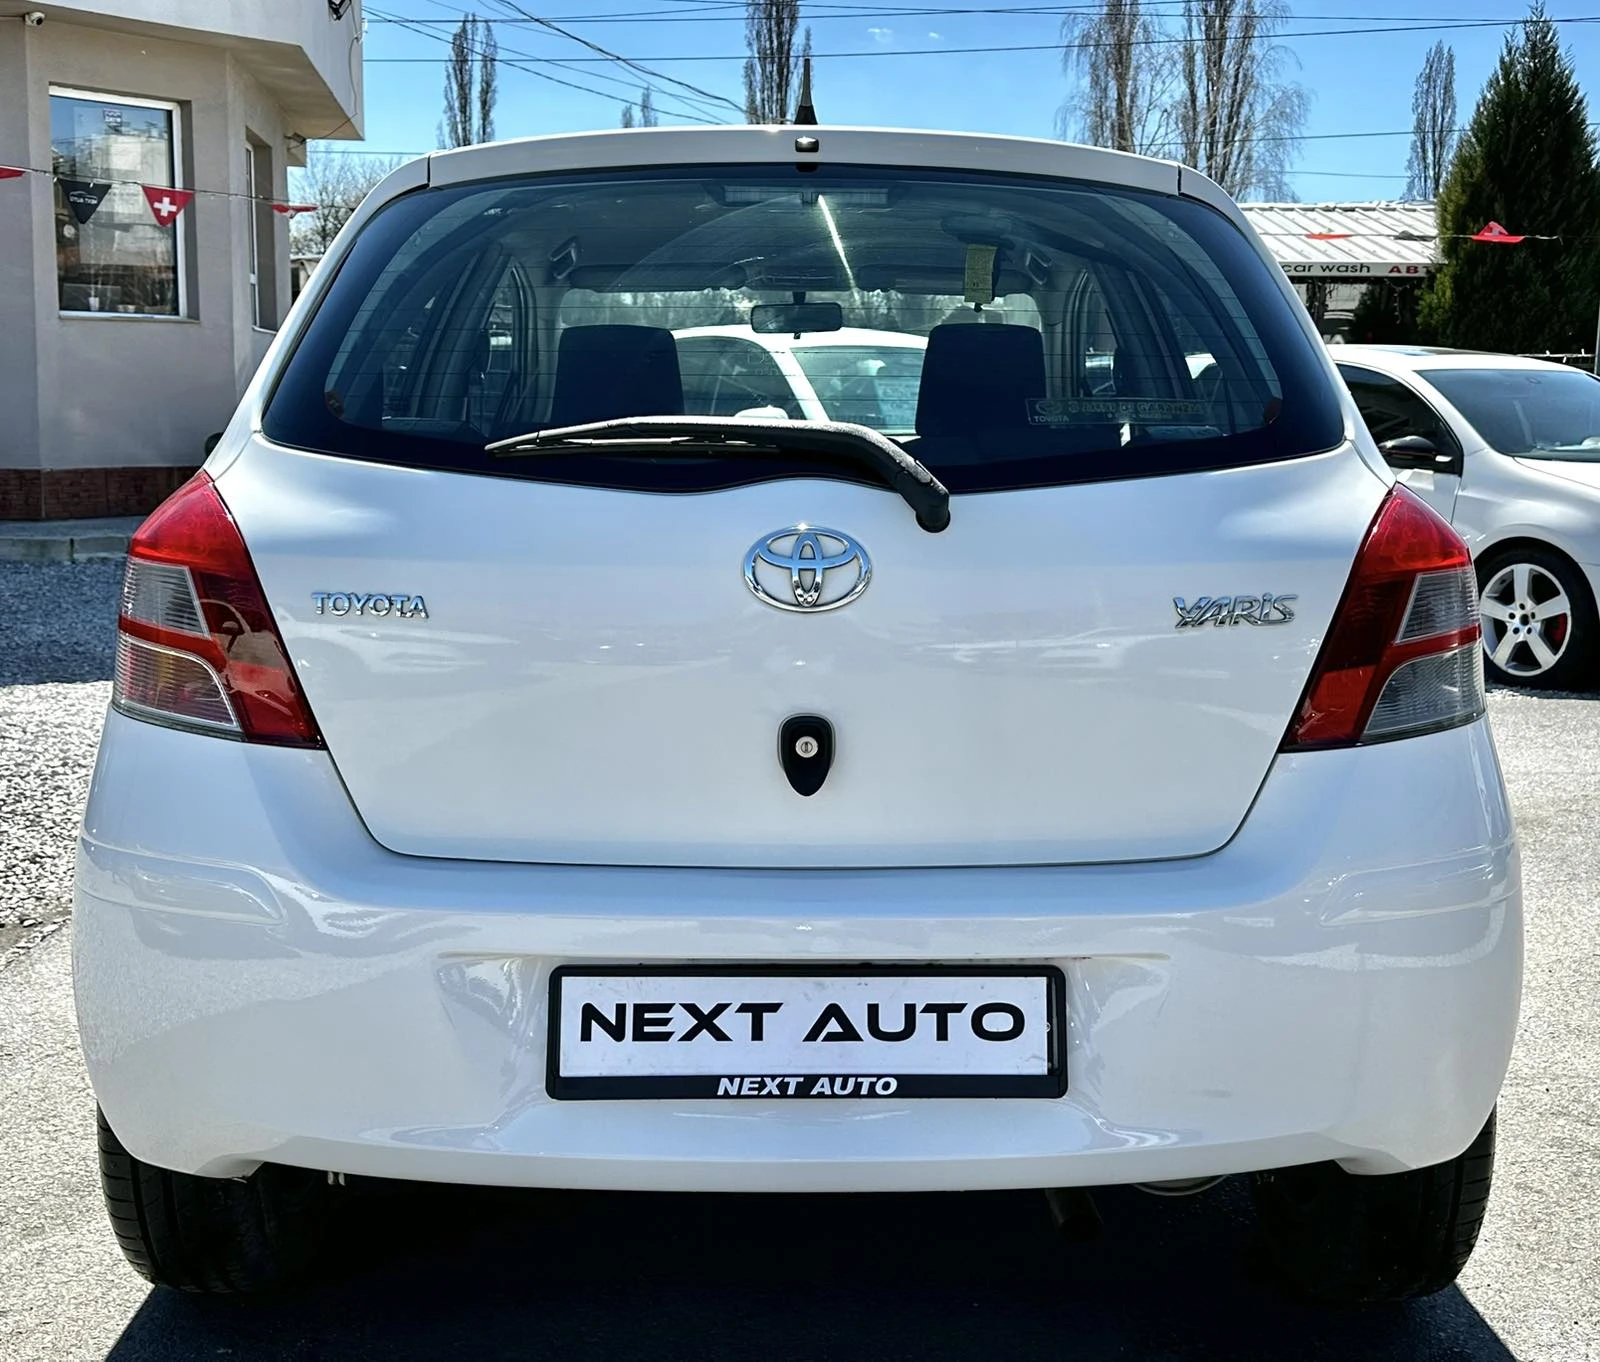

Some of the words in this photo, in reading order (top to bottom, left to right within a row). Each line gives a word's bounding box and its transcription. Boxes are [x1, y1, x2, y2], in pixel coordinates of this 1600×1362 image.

[1281, 263, 1314, 273] car
[1320, 262, 1371, 274] wash
[311, 592, 429, 619] TOYOTA
[580, 1002, 784, 1043] NEXT
[802, 1002, 1026, 1042] AUTO
[716, 1077, 804, 1096] NEXT
[810, 1077, 898, 1096] AUTO
